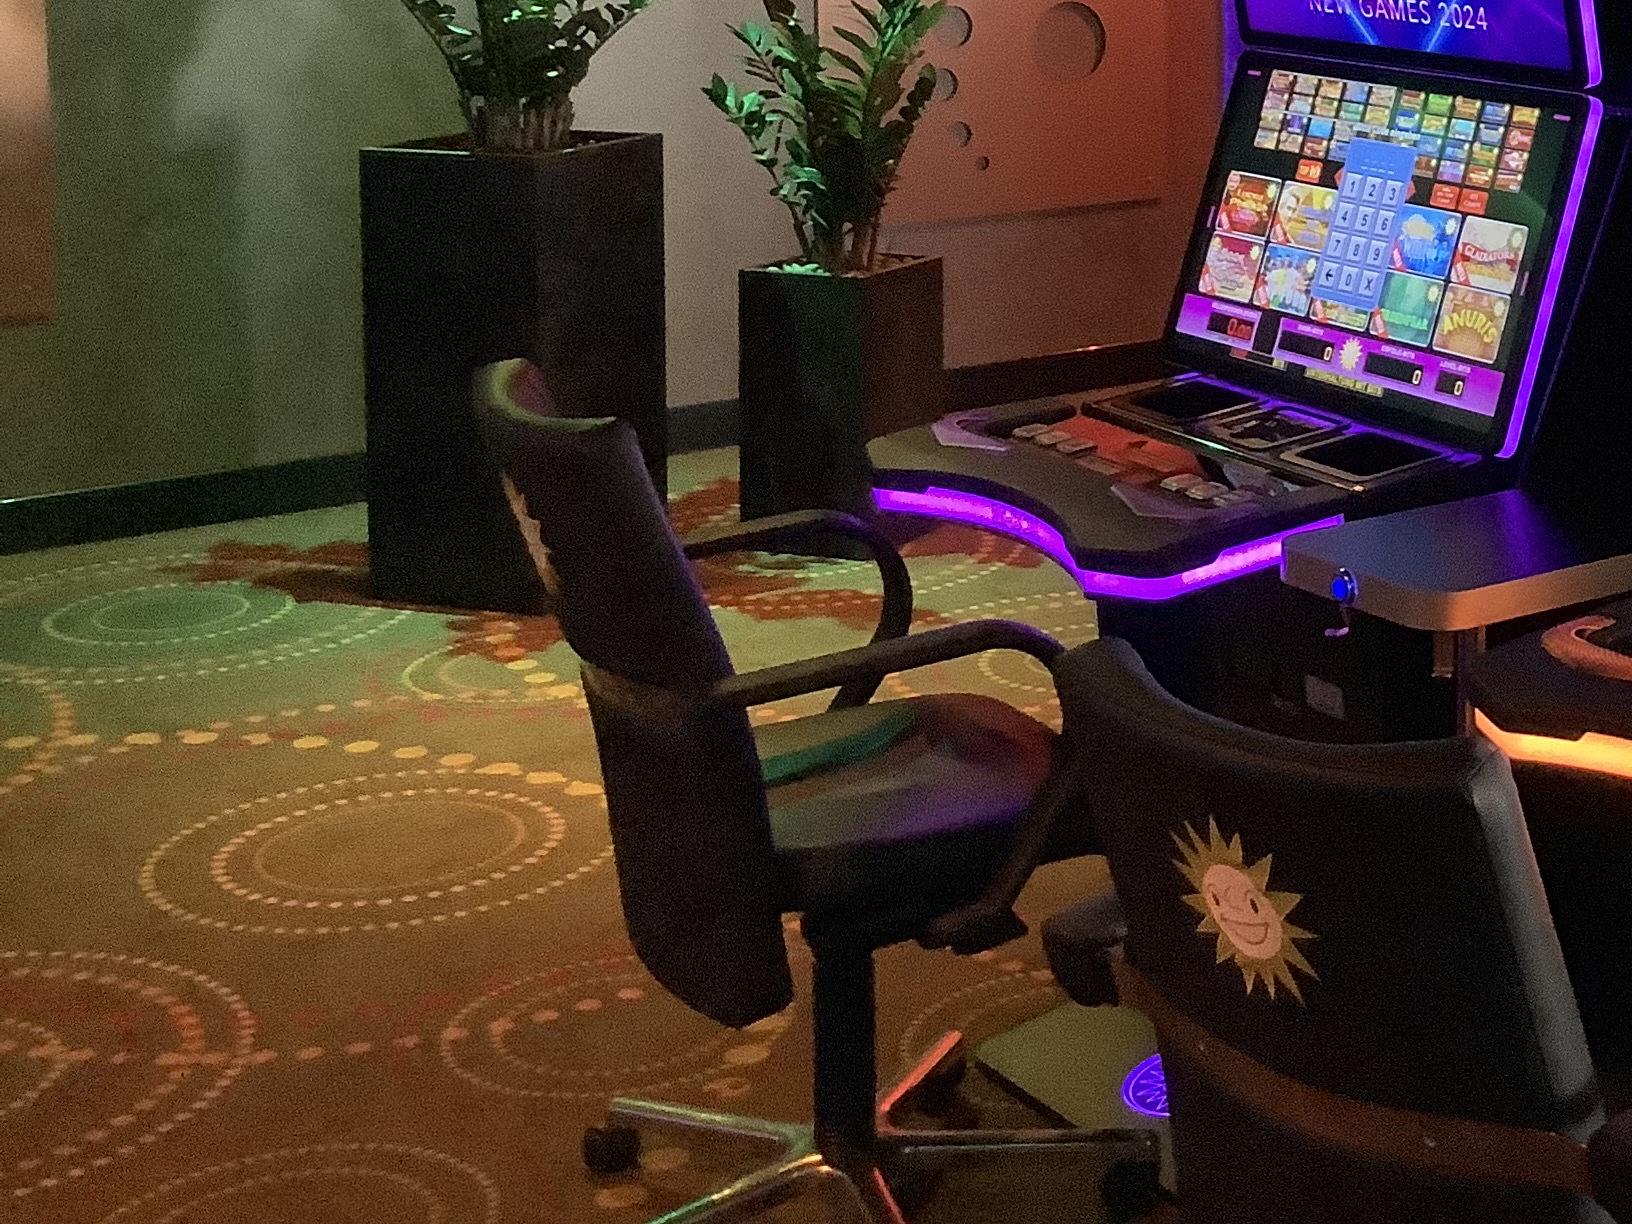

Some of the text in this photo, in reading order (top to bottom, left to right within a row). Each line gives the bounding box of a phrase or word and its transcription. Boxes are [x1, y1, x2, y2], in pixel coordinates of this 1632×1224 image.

[1438, 2, 1489, 31] 2024
[1350, 181, 1356, 193] 1
[1369, 184, 1376, 197] 2
[1389, 188, 1396, 200] 3
[1341, 210, 1349, 223] 4
[1361, 214, 1368, 226] 5
[1381, 218, 1388, 231] 6
[1334, 240, 1340, 251] 7
[1353, 244, 1360, 256] 8
[1373, 248, 1380, 260] 9
[1345, 274, 1352, 286] 0
[1443, 309, 1498, 343] ANURIS
[1323, 346, 1332, 361] 0
[1412, 369, 1421, 385] 0
[1454, 380, 1463, 396] 0
